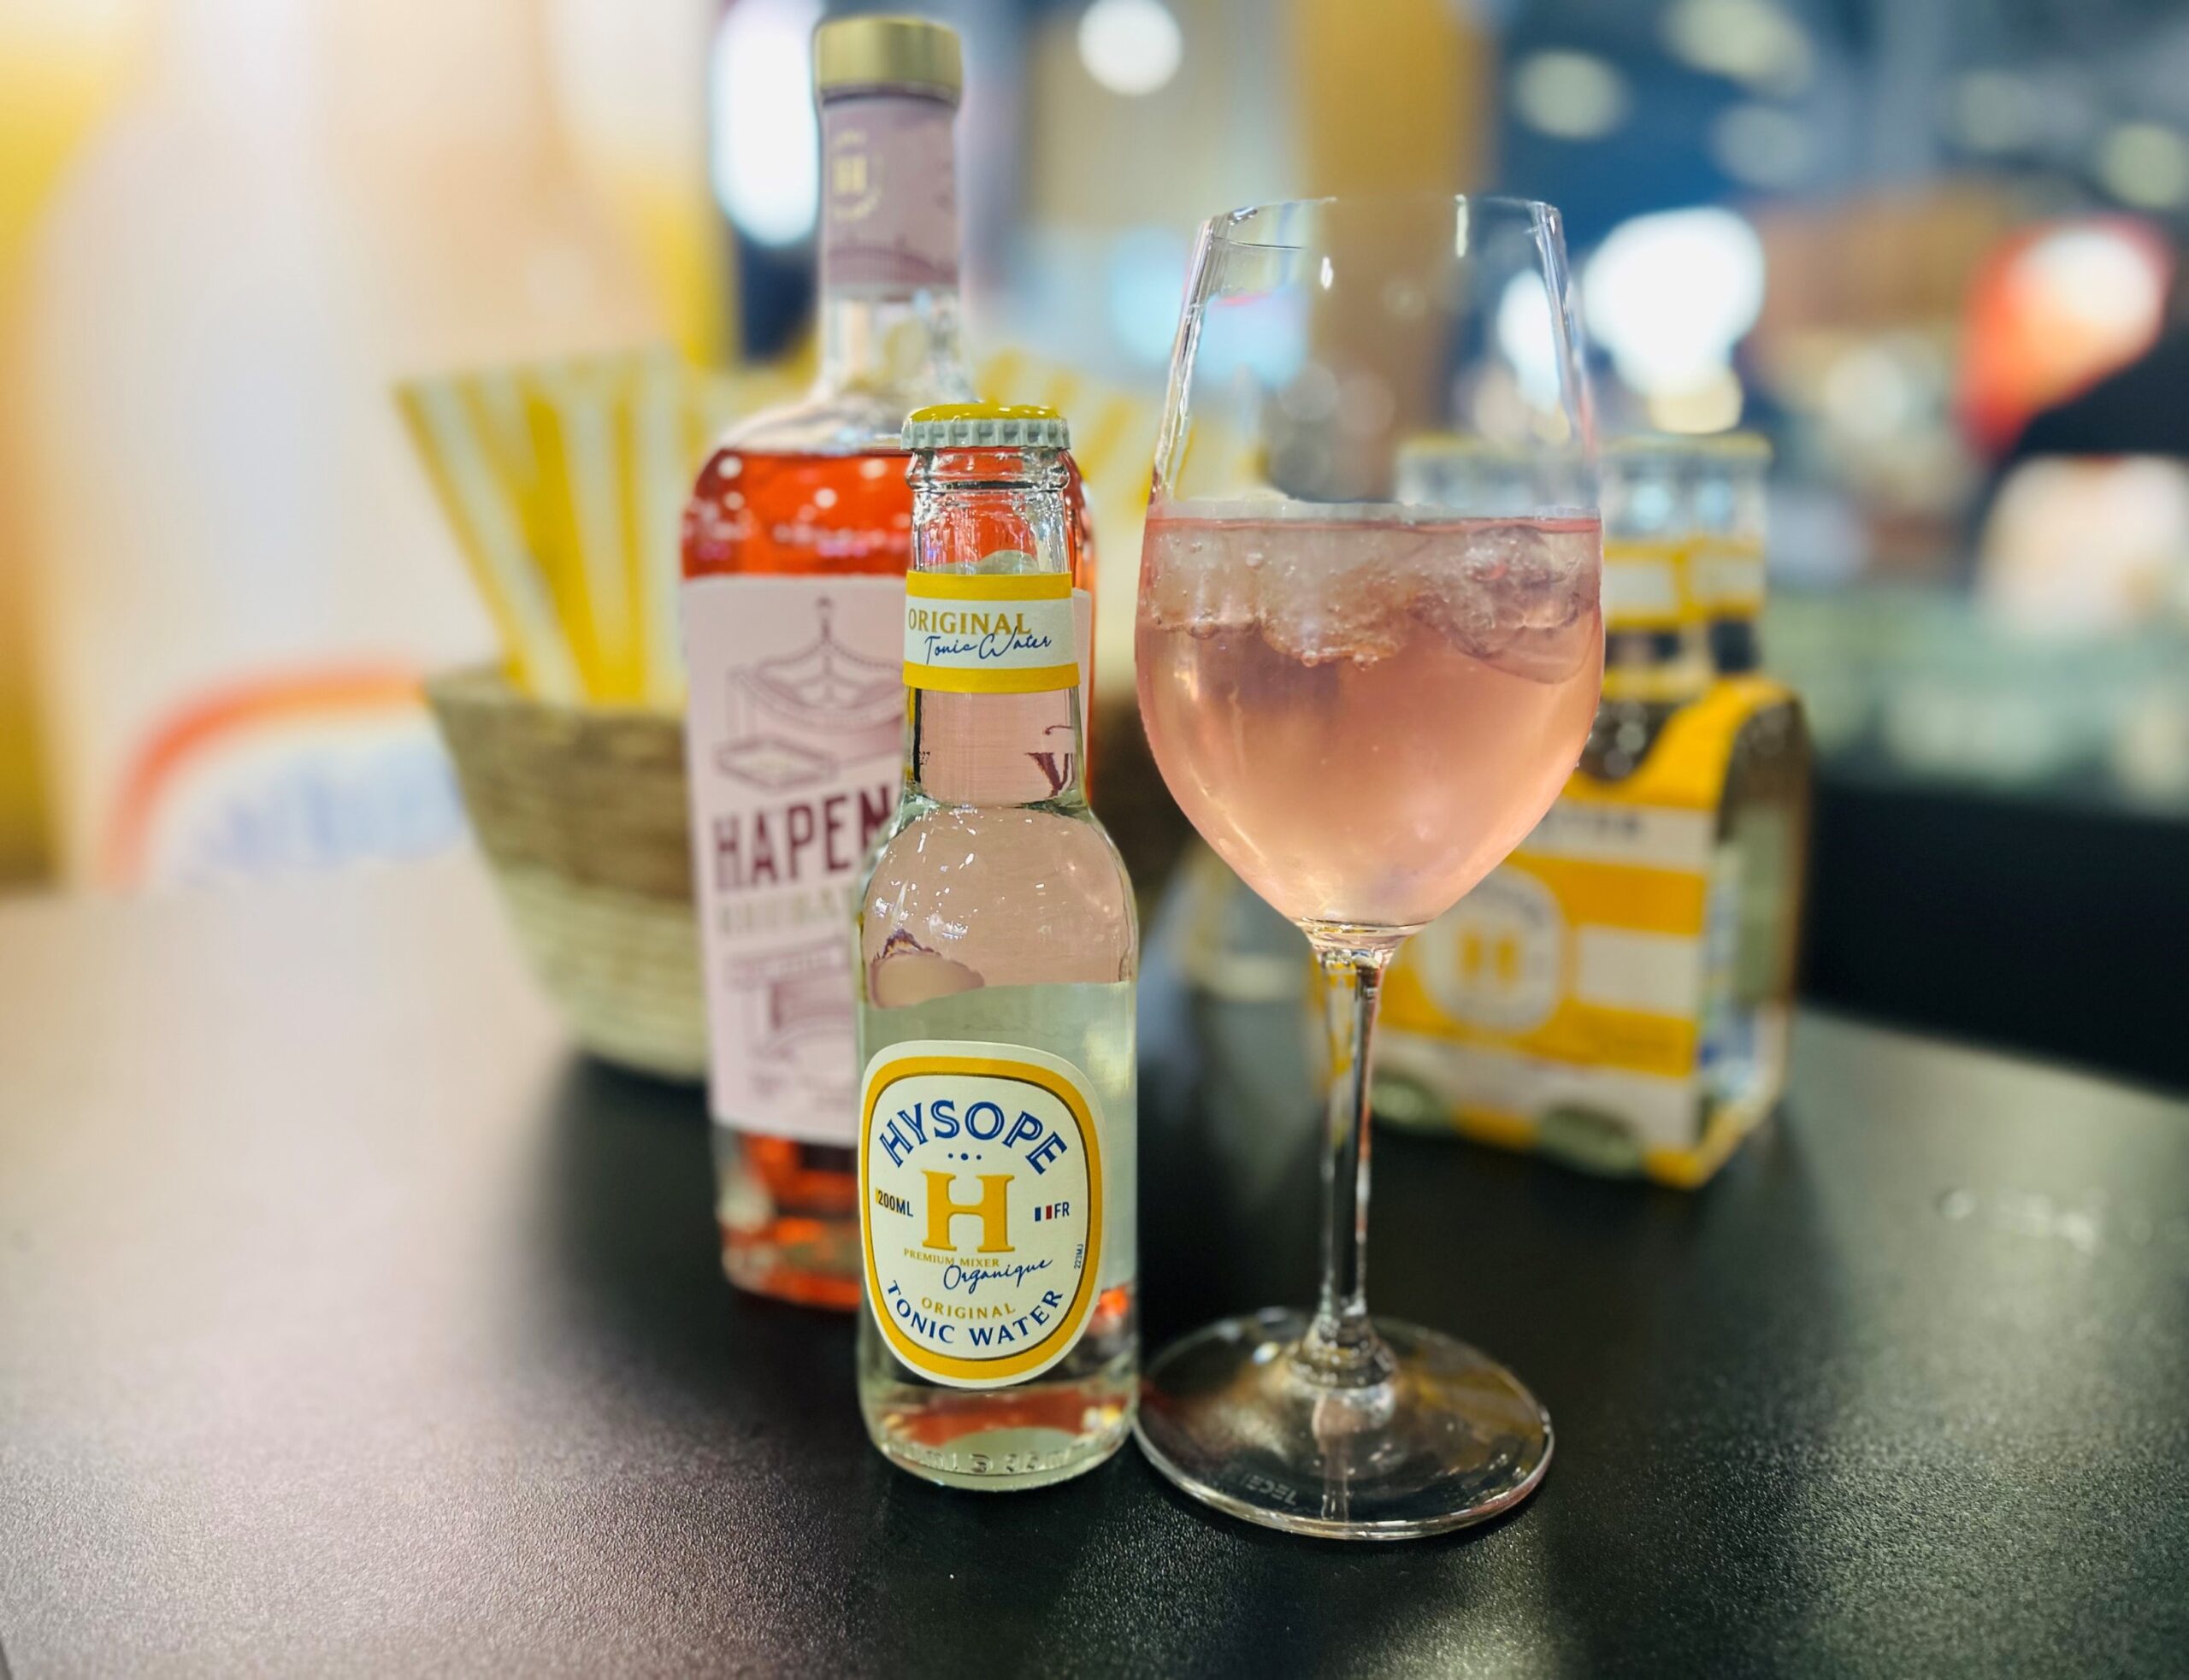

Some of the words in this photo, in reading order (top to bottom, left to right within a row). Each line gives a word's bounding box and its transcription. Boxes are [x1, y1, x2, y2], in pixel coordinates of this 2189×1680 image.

[908, 608, 1031, 636] ORIGINAL
[924, 635, 978, 665] Tonic
[978, 626, 1052, 659] Water
[879, 1099, 1067, 1176] HYSOPE
[877, 1189, 913, 1217] 200ML
[921, 1169, 1015, 1253] H
[1054, 1201, 1070, 1218] FR
[904, 1247, 955, 1265] PREMIUM
[959, 1258, 1000, 1268] MIXER
[943, 1259, 1053, 1295] Organique
[887, 1280, 955, 1344] TONIC
[968, 1288, 1064, 1347] WATER
[920, 1297, 1016, 1320] ORIGINAL
